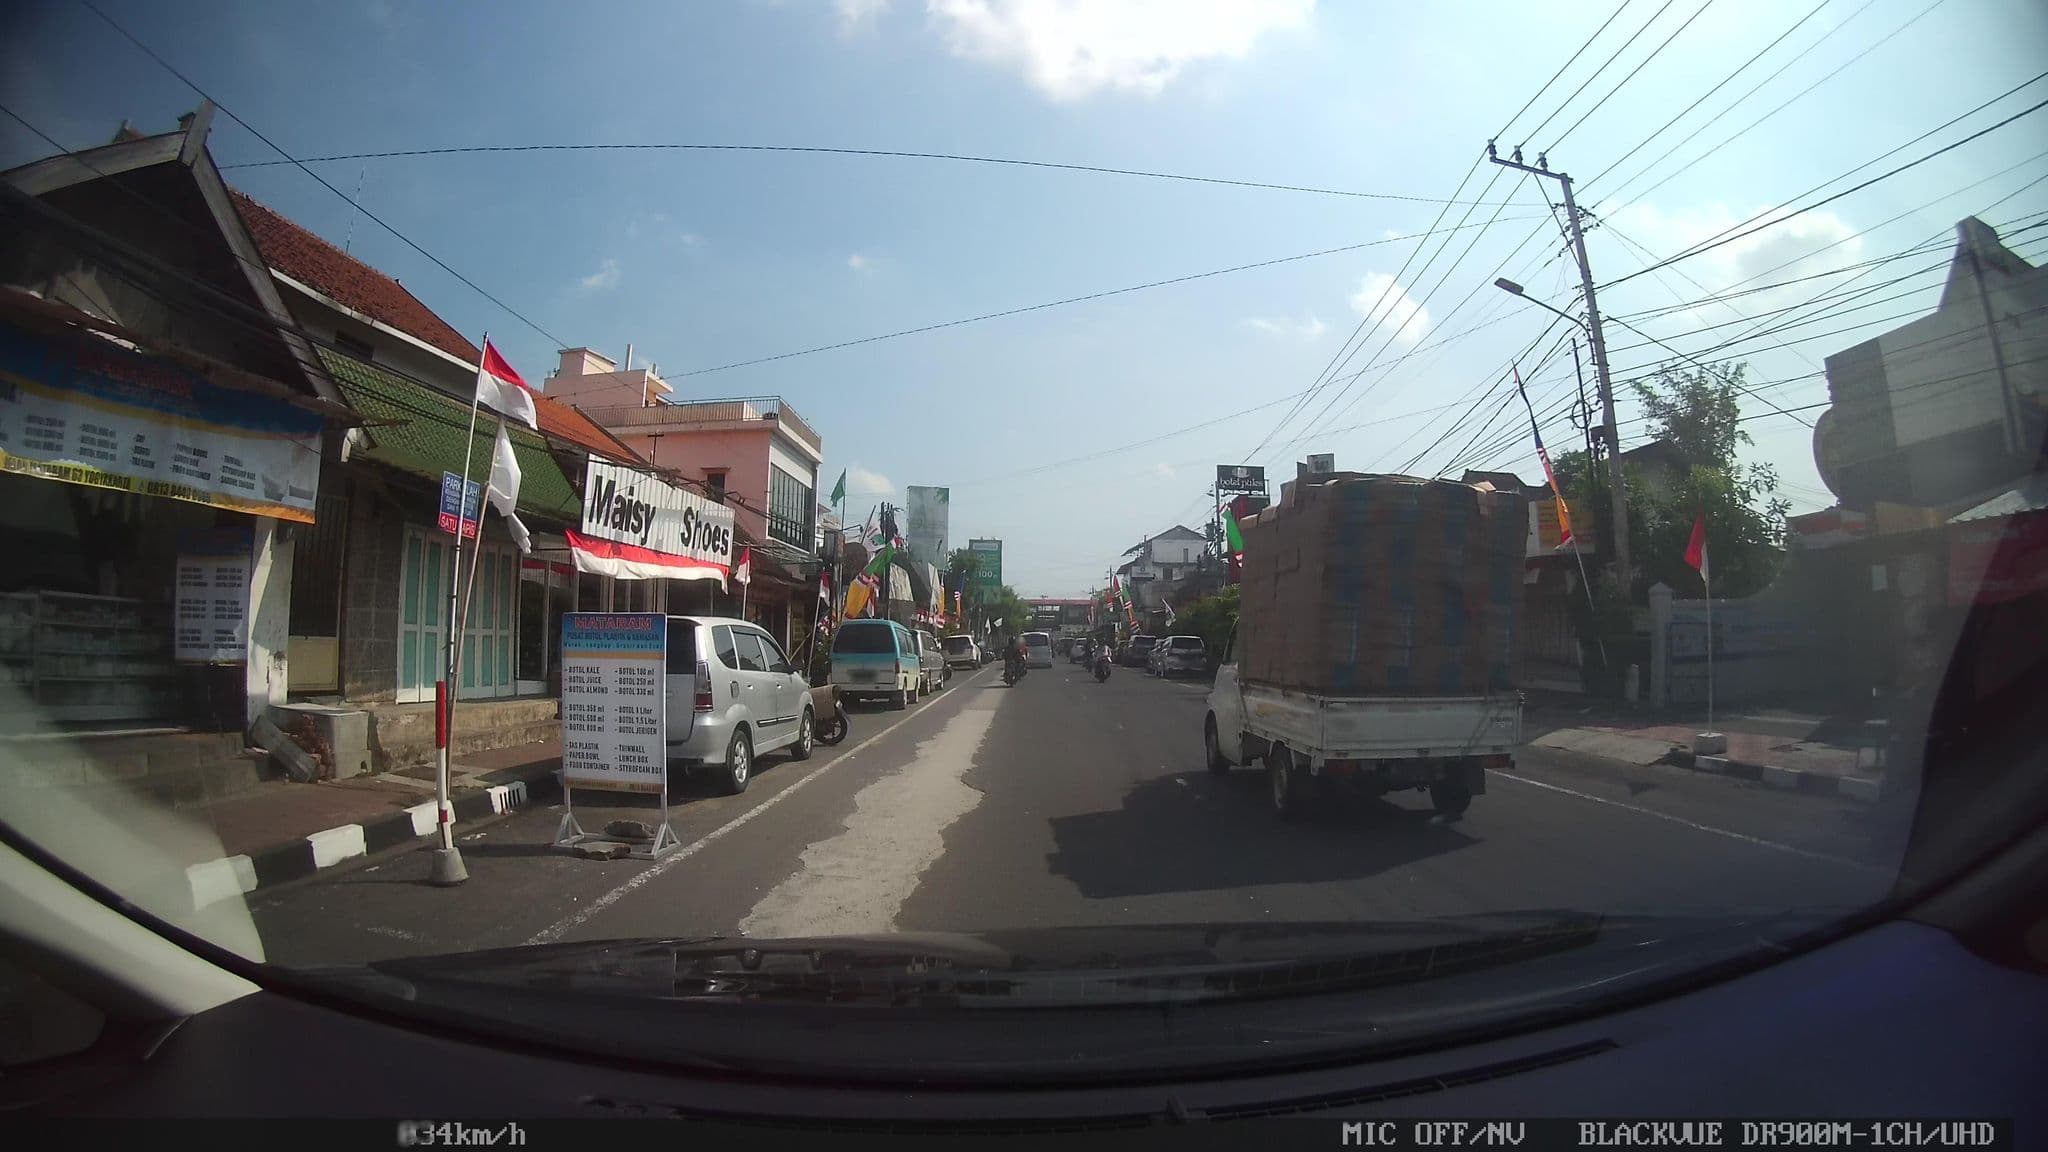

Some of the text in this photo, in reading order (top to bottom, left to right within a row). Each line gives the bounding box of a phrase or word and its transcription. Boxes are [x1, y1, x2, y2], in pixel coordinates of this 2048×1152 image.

[1220, 477, 1240, 488] hotel
[588, 474, 730, 556] Maisy Shoes
[440, 515, 457, 531] SATU
[978, 570, 993, 578] 100
[575, 616, 651, 630] MATARAM
[569, 666, 585, 674] BOTOL
[619, 667, 635, 675] BOTOL
[569, 676, 601, 684] BOTOL JUICE
[619, 677, 635, 685] BOTOL
[569, 686, 608, 694] BOTOL ALMOND
[619, 687, 635, 695] BOTOL
[569, 704, 585, 712] BOTOL
[619, 706, 635, 714] BOTOL
[640, 706, 653, 715] Liter
[569, 714, 585, 722] BOTOL
[619, 716, 635, 724] BOTOL
[644, 717, 657, 725] Liter
[569, 723, 585, 731] BOTOL
[619, 726, 635, 734] BOTOL
[569, 741, 599, 751] TAS PLASTIK
[619, 744, 646, 754] THINWALL
[569, 751, 600, 760] PAPER BOWL
[619, 754, 649, 764] LUNCH BOX
[569, 761, 610, 771] FOOD CONTAINER
[619, 764, 663, 775] STYROFOAM BOX
